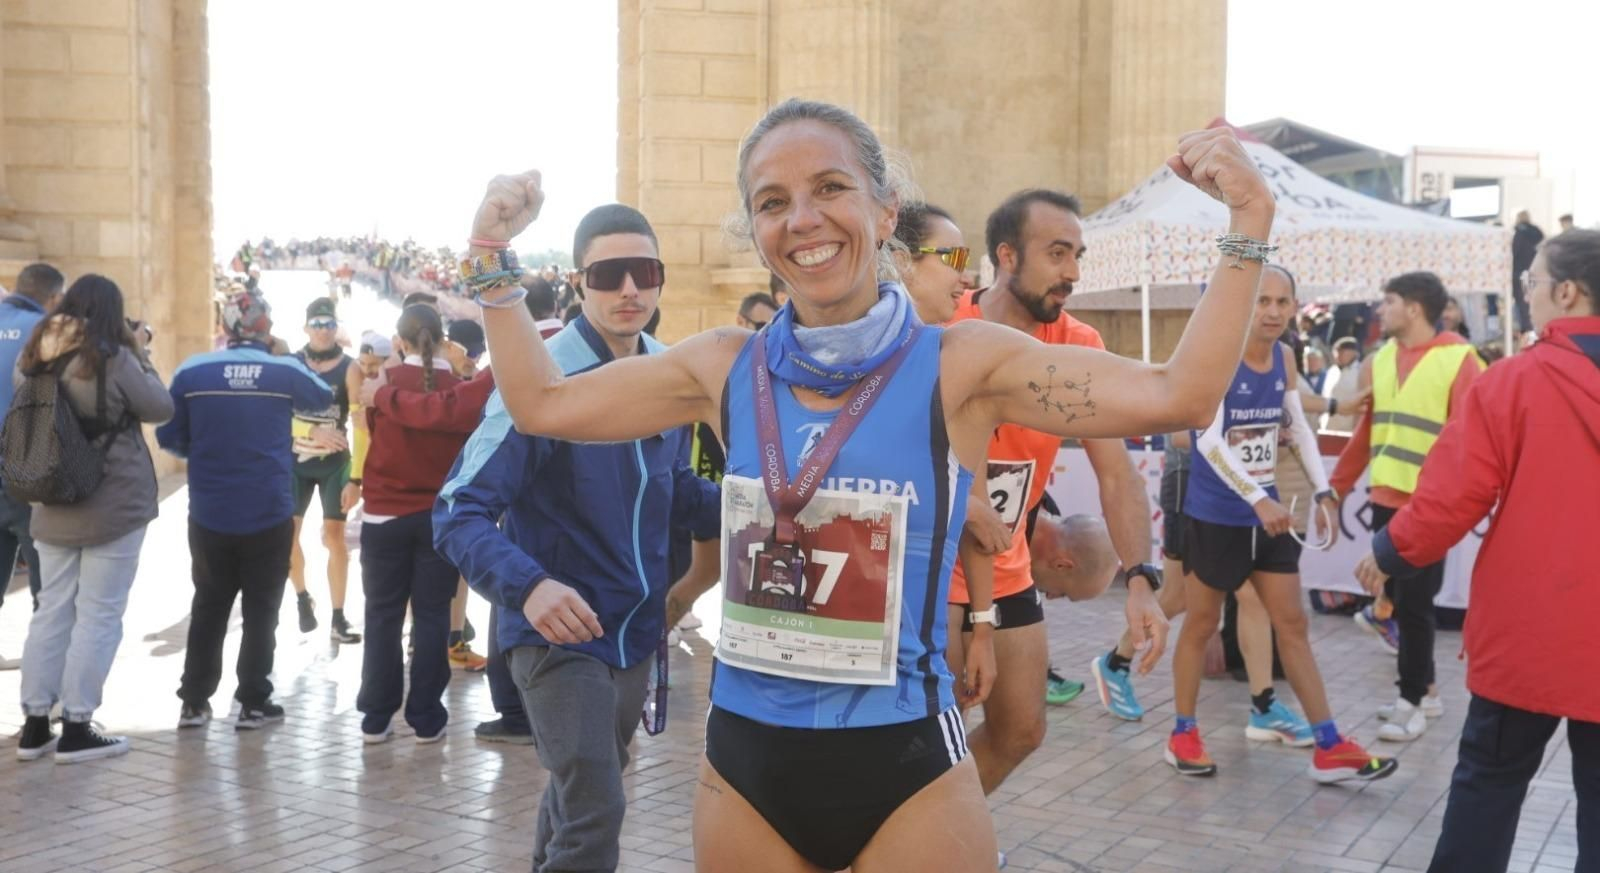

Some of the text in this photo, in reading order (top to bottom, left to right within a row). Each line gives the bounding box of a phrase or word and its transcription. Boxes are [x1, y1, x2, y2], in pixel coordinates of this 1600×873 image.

[224, 364, 262, 378] STAFF
[797, 465, 821, 498] MEDIA
[848, 374, 884, 416] CORDOBA
[1241, 443, 1272, 463] 326
[765, 443, 781, 493] CORDOBA
[780, 652, 793, 662] 187
